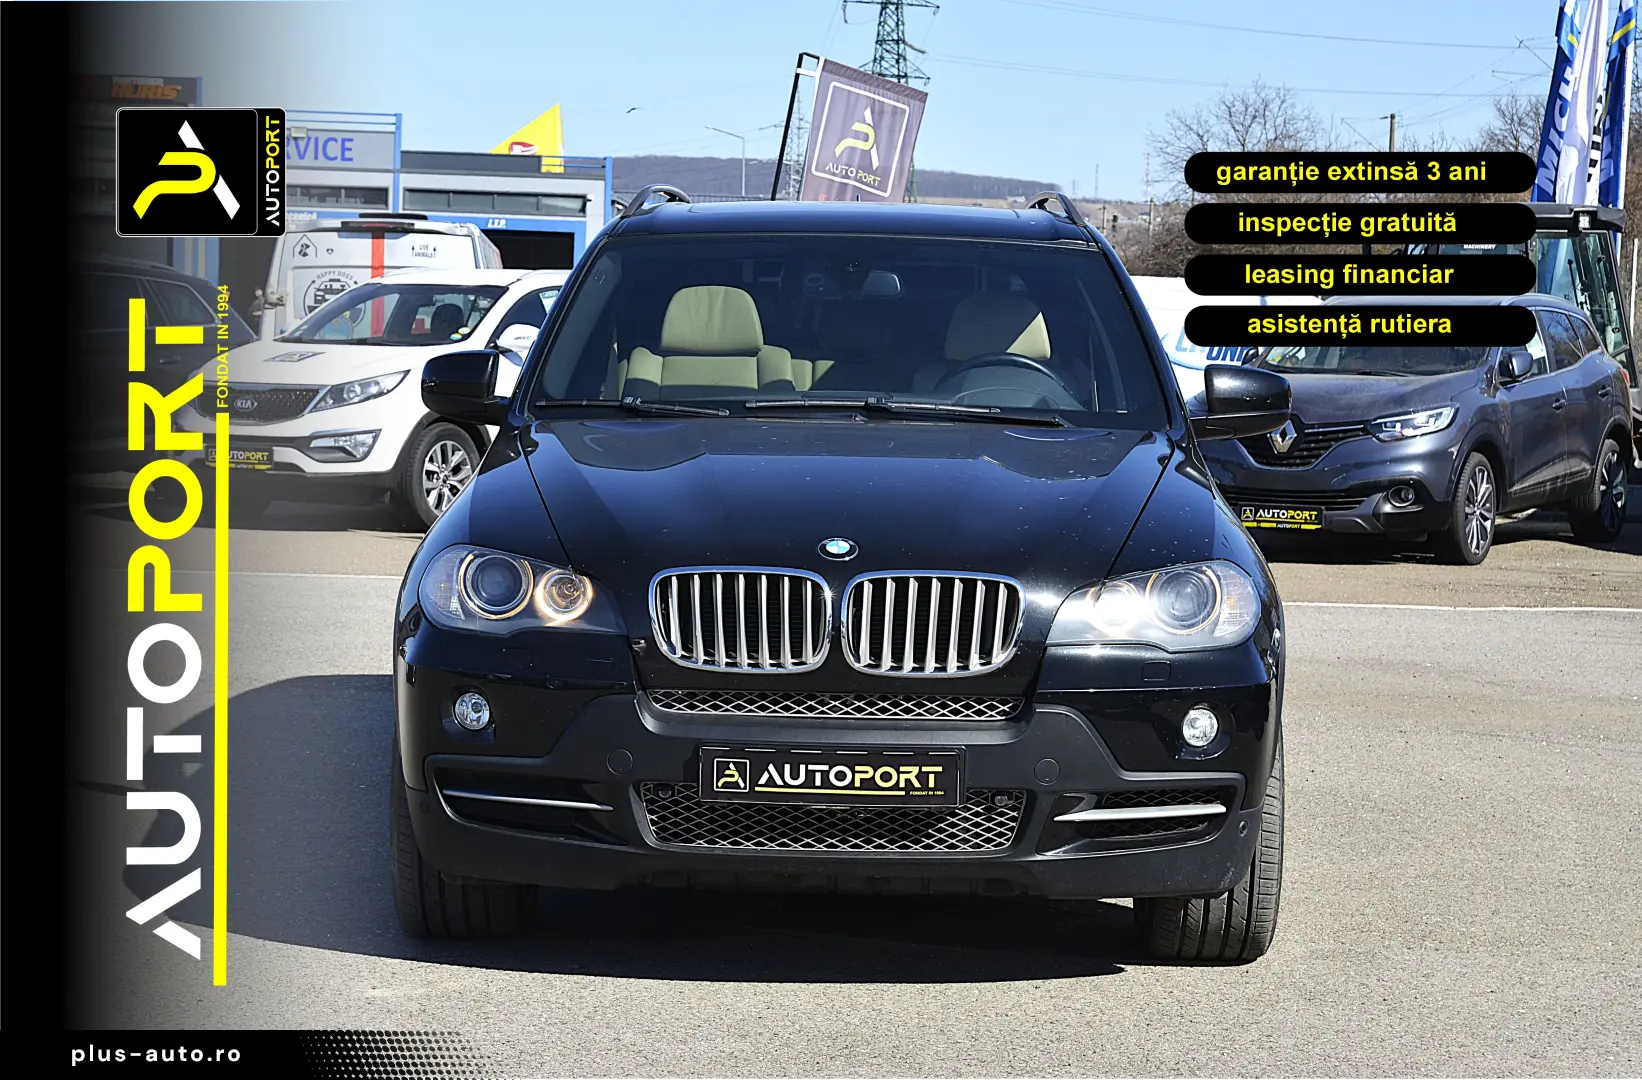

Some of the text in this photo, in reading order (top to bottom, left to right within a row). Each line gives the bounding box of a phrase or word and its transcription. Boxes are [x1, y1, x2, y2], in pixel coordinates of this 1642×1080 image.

[236, 400, 252, 408] KIA
[1256, 508, 1318, 521] AUTOPORT
[757, 762, 943, 789] AUTOPORT
